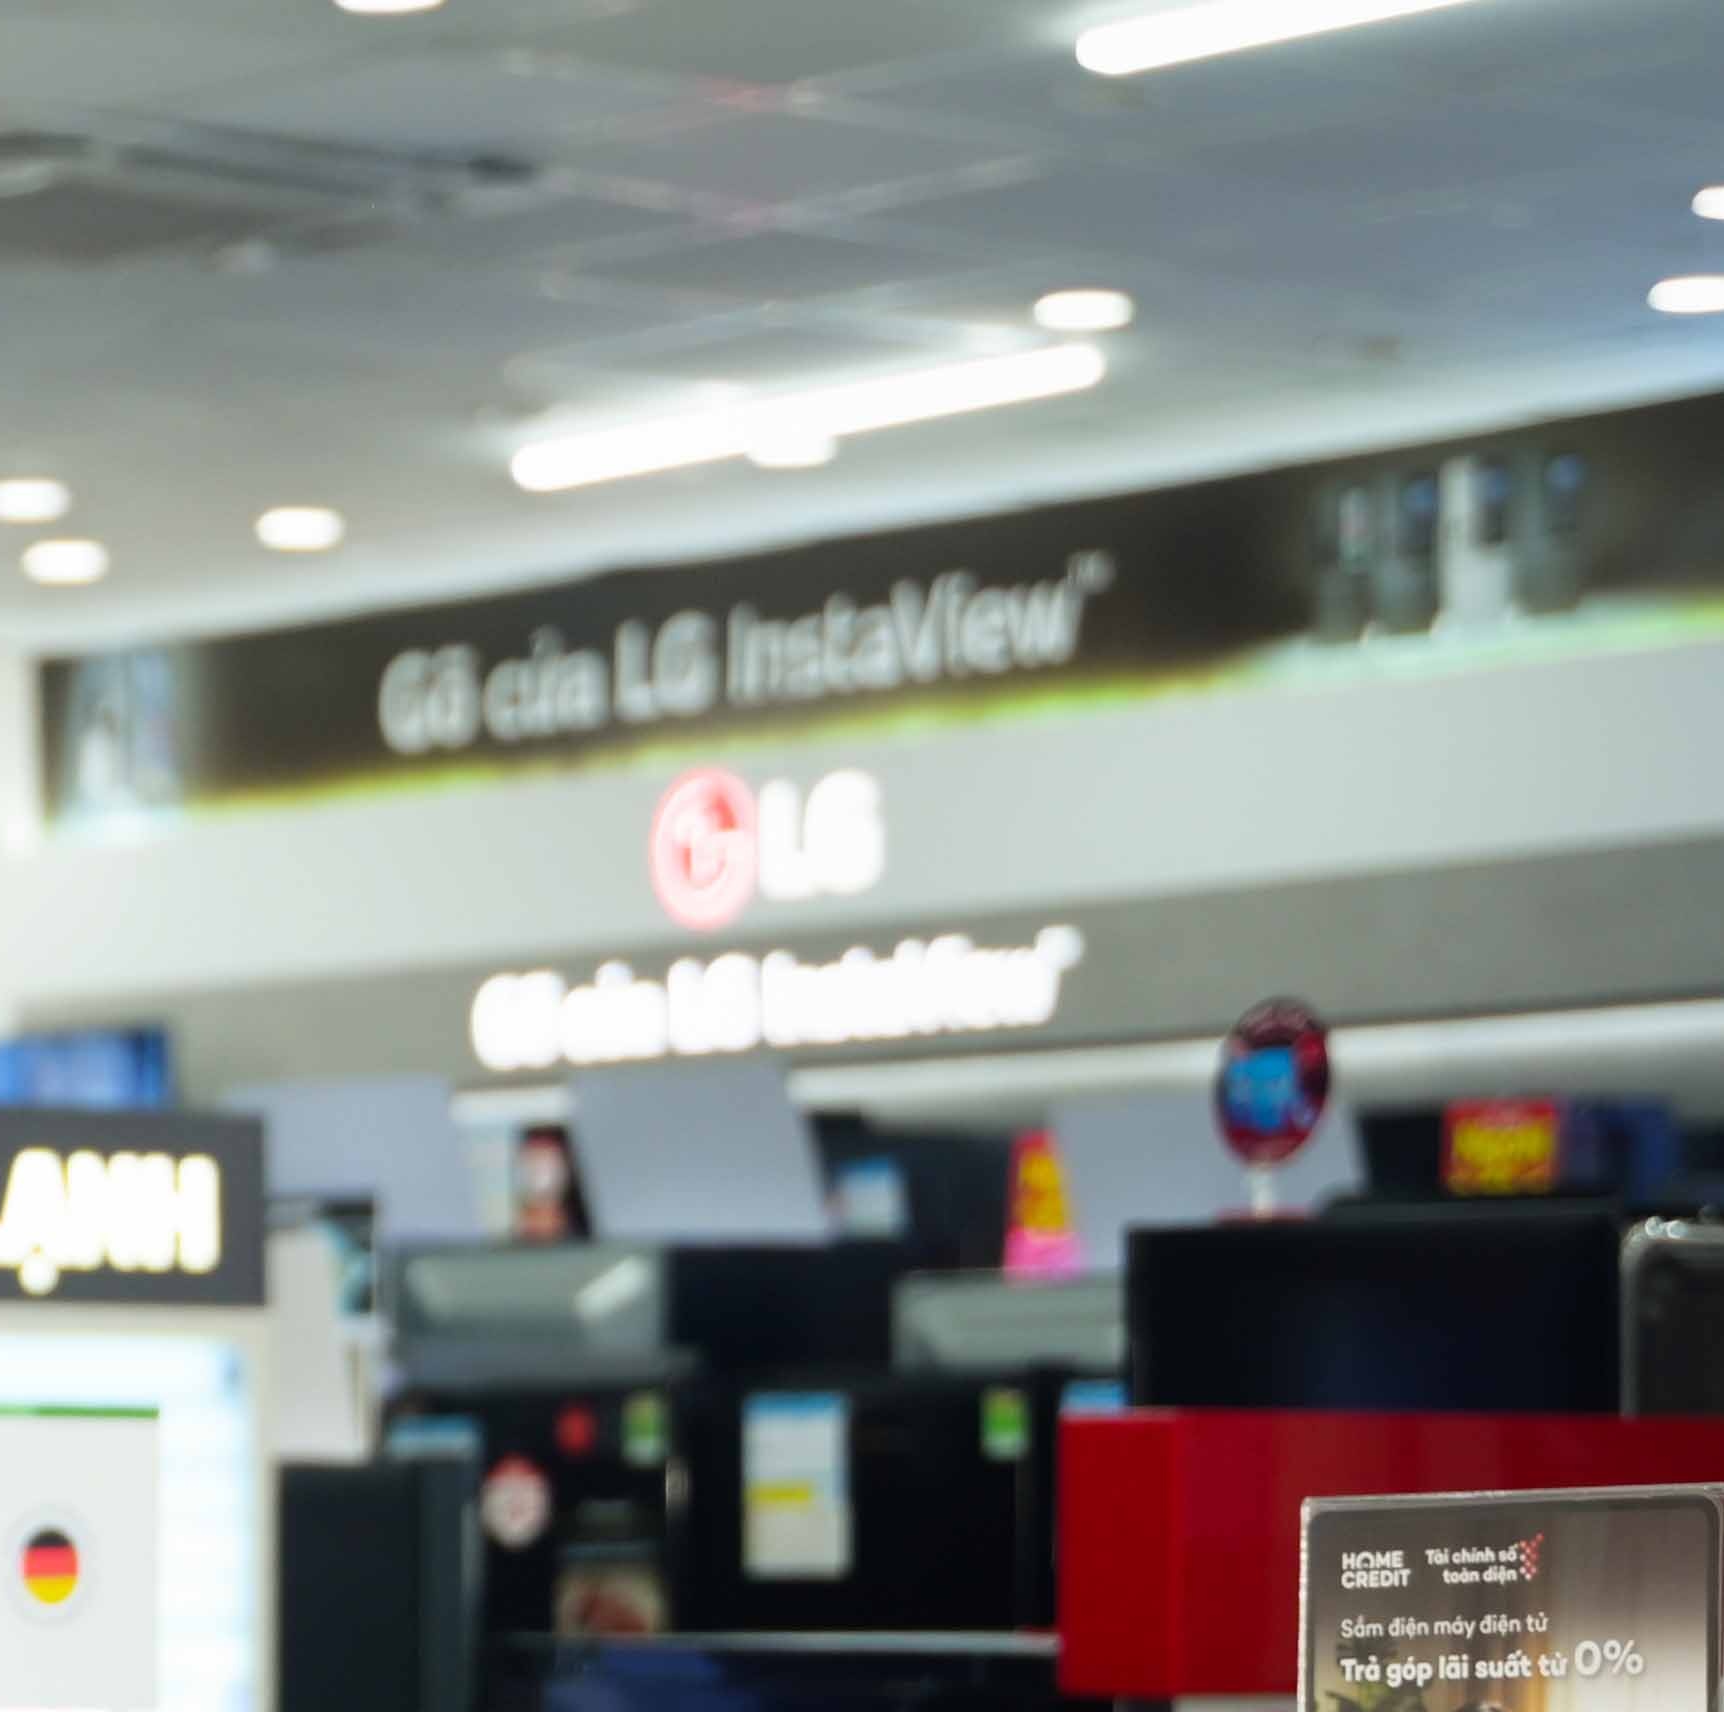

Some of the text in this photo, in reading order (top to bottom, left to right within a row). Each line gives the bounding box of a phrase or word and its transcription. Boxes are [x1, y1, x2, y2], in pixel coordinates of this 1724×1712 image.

[614, 609, 717, 723] LG
[757, 769, 884, 902] LG
[1342, 1551, 1404, 1570] HOME
[1452, 1547, 1494, 1565] chính
[1341, 1570, 1411, 1589] CREDIT
[1388, 1616, 1428, 1639] điện
[1434, 1614, 1476, 1640] máy
[1480, 1614, 1521, 1637] điện
[1526, 1611, 1549, 1634] tử
[1340, 1640, 1644, 1687] Trả góp lãi suất từ 0%
